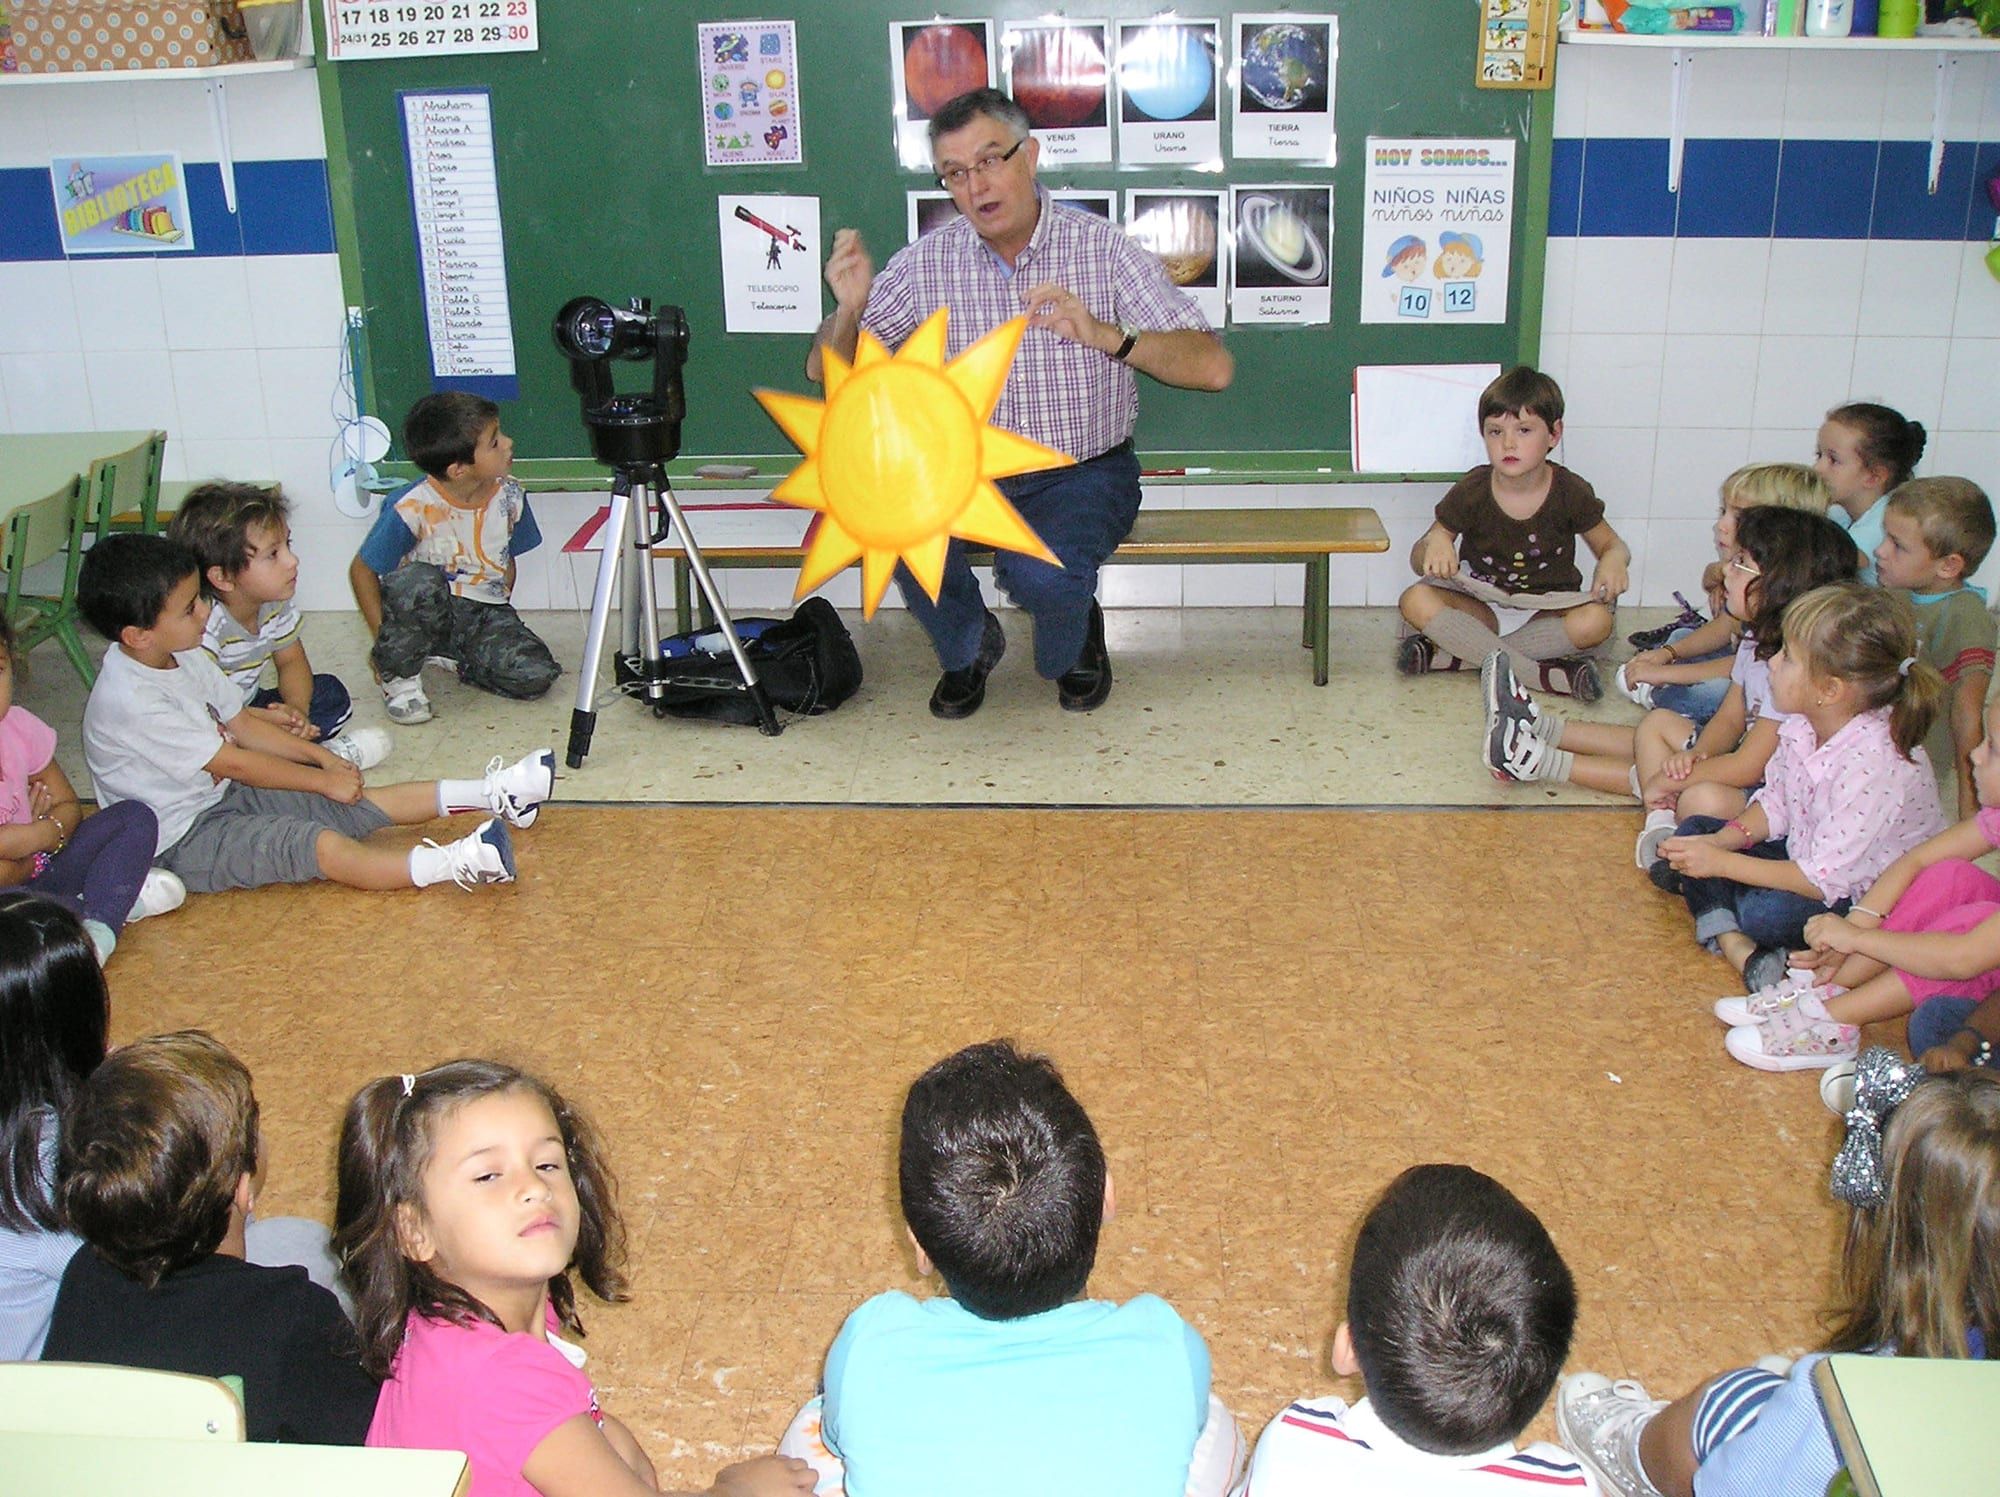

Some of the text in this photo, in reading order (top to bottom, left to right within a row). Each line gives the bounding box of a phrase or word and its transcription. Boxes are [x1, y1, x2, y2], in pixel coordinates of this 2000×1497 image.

[342, 1, 528, 25] 17 18 19 20 21 22 23
[341, 25, 529, 47] 24/31 25 26 27 28 29 30
[424, 100, 473, 110] Abraham
[464, 124, 471, 133] A
[1268, 124, 1300, 133] TIERRA
[1046, 133, 1076, 142] VENUS
[1153, 131, 1185, 141] URANO
[1268, 136, 1300, 146] Tierra
[427, 138, 467, 148] Andrea
[1154, 143, 1187, 153] Urano
[1046, 144, 1078, 154] Venus
[1375, 148, 1508, 167] HOY SOMOS...
[64, 161, 177, 238] BIBLIOTECA
[1373, 186, 1506, 205] NIÑOS NIÑAS
[1372, 204, 1504, 222] niños niñas
[439, 259, 478, 270] Marina
[747, 284, 800, 293] TELESCOPIO
[1260, 294, 1302, 303] SATURNO
[1403, 289, 1471, 311] 10 12
[751, 301, 797, 312] Telescopio
[1258, 306, 1300, 316] Saturno
[445, 318, 482, 329] Ricardo
[447, 331, 476, 341] Luna
[451, 366, 493, 375] Ximena
